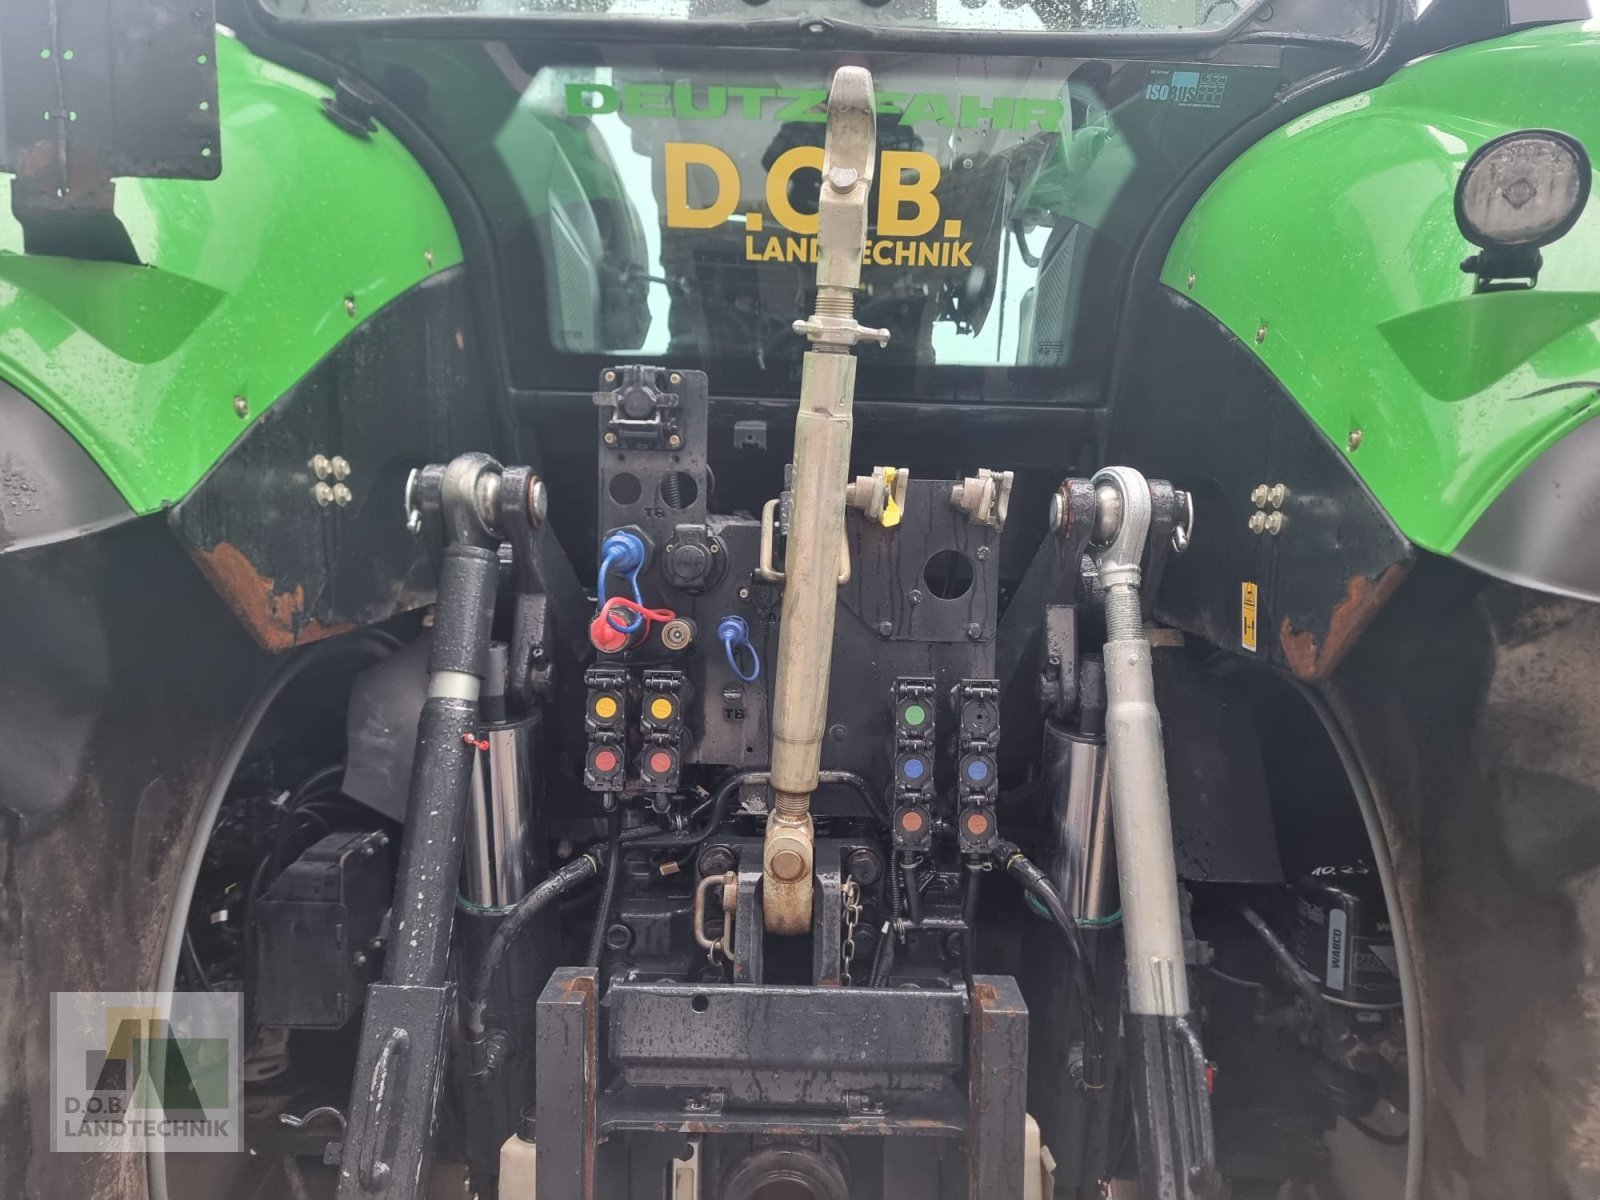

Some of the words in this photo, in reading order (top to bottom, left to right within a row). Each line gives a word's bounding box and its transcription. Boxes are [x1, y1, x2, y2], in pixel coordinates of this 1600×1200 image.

[1145, 84, 1197, 102] ISOBUS
[664, 142, 963, 238] D.OB.
[746, 235, 973, 267] LANECHNIK
[1331, 928, 1342, 969] WABCO
